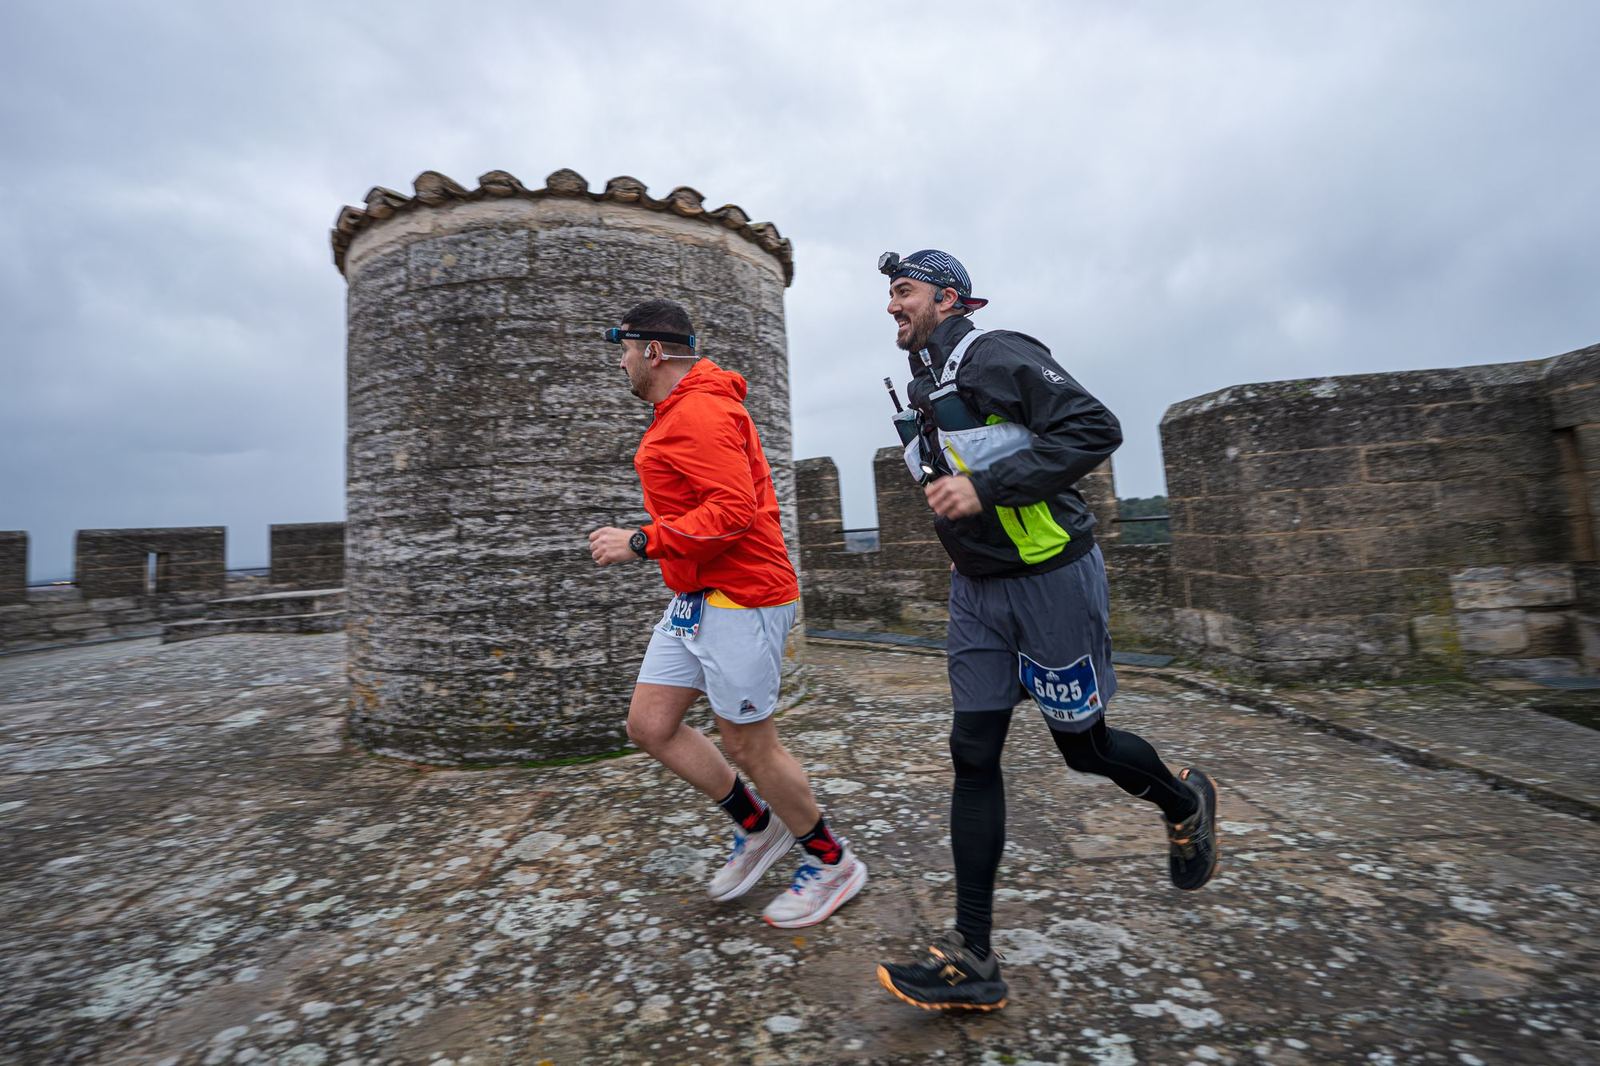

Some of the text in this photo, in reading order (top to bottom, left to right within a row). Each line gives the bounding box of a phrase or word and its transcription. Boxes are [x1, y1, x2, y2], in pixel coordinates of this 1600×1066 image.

[1034, 676, 1083, 703] 5425
[1053, 708, 1075, 720] 20 K
